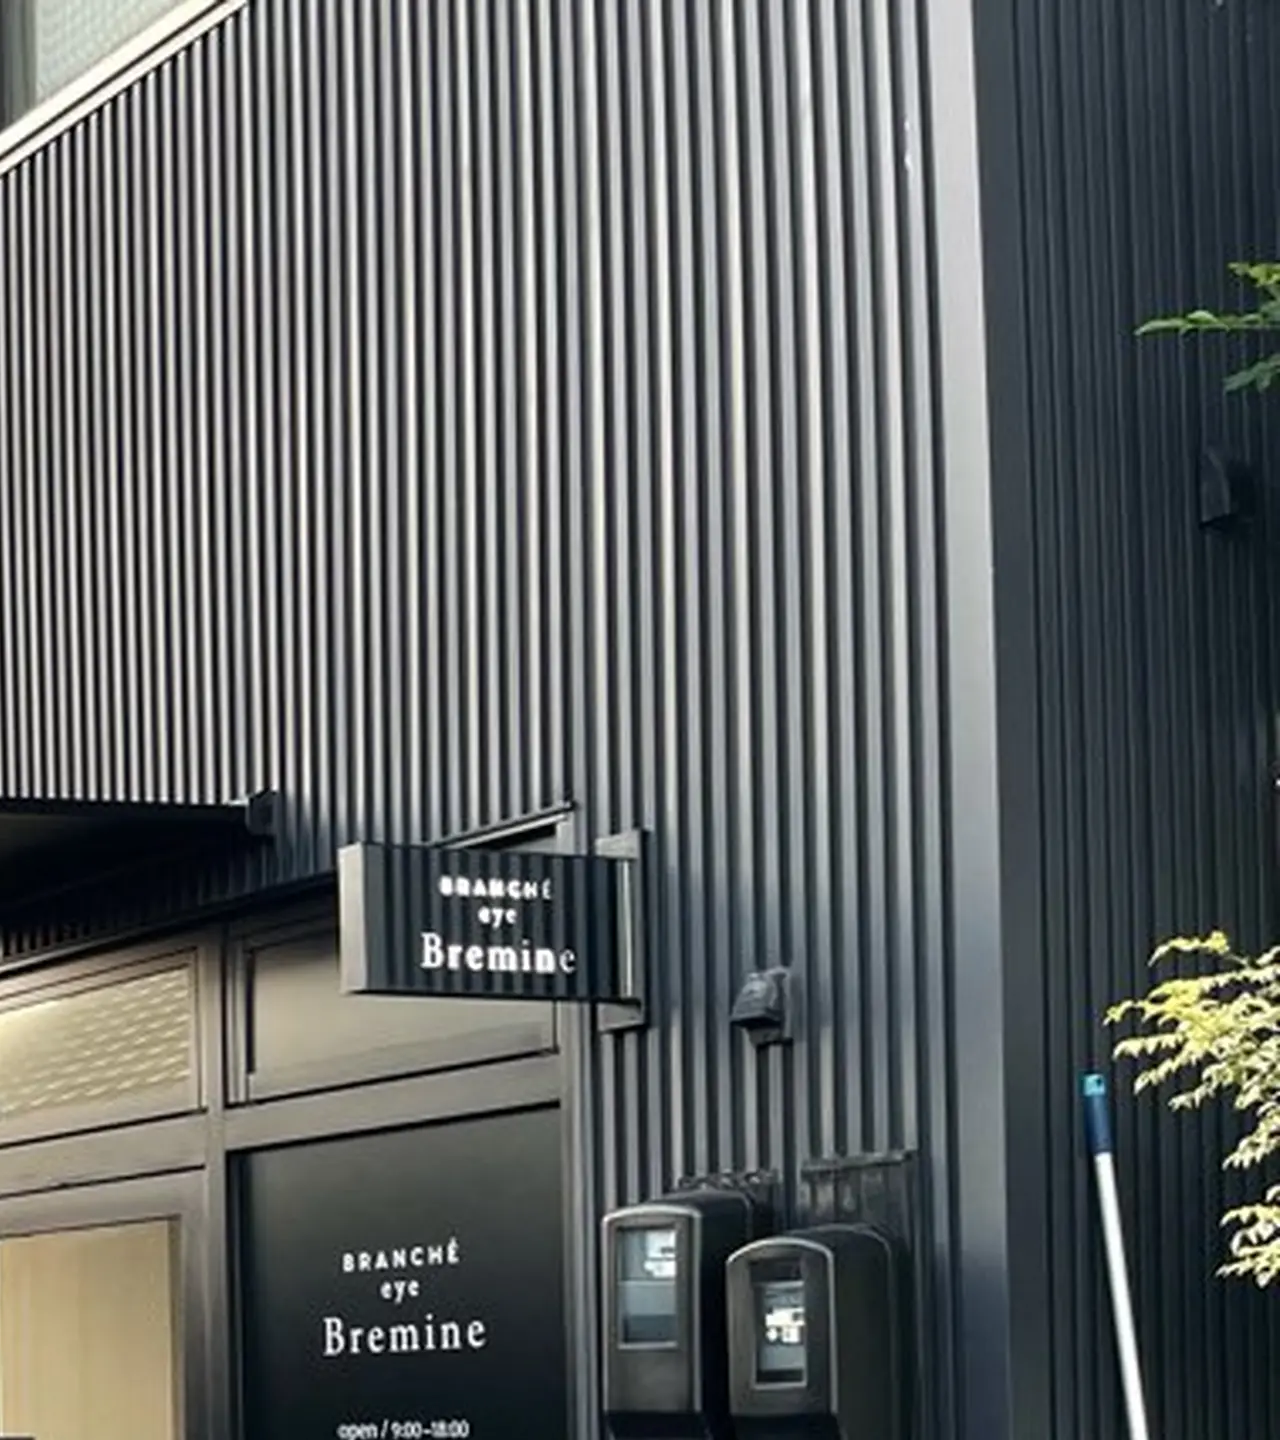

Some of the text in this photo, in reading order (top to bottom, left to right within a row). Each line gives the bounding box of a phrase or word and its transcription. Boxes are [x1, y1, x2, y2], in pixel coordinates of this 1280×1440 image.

[477, 905, 518, 929] eye
[420, 931, 577, 975] Bremine
[342, 1236, 460, 1273] BRANCHÉ
[380, 1280, 420, 1305] eye
[322, 1313, 487, 1357] Bremine
